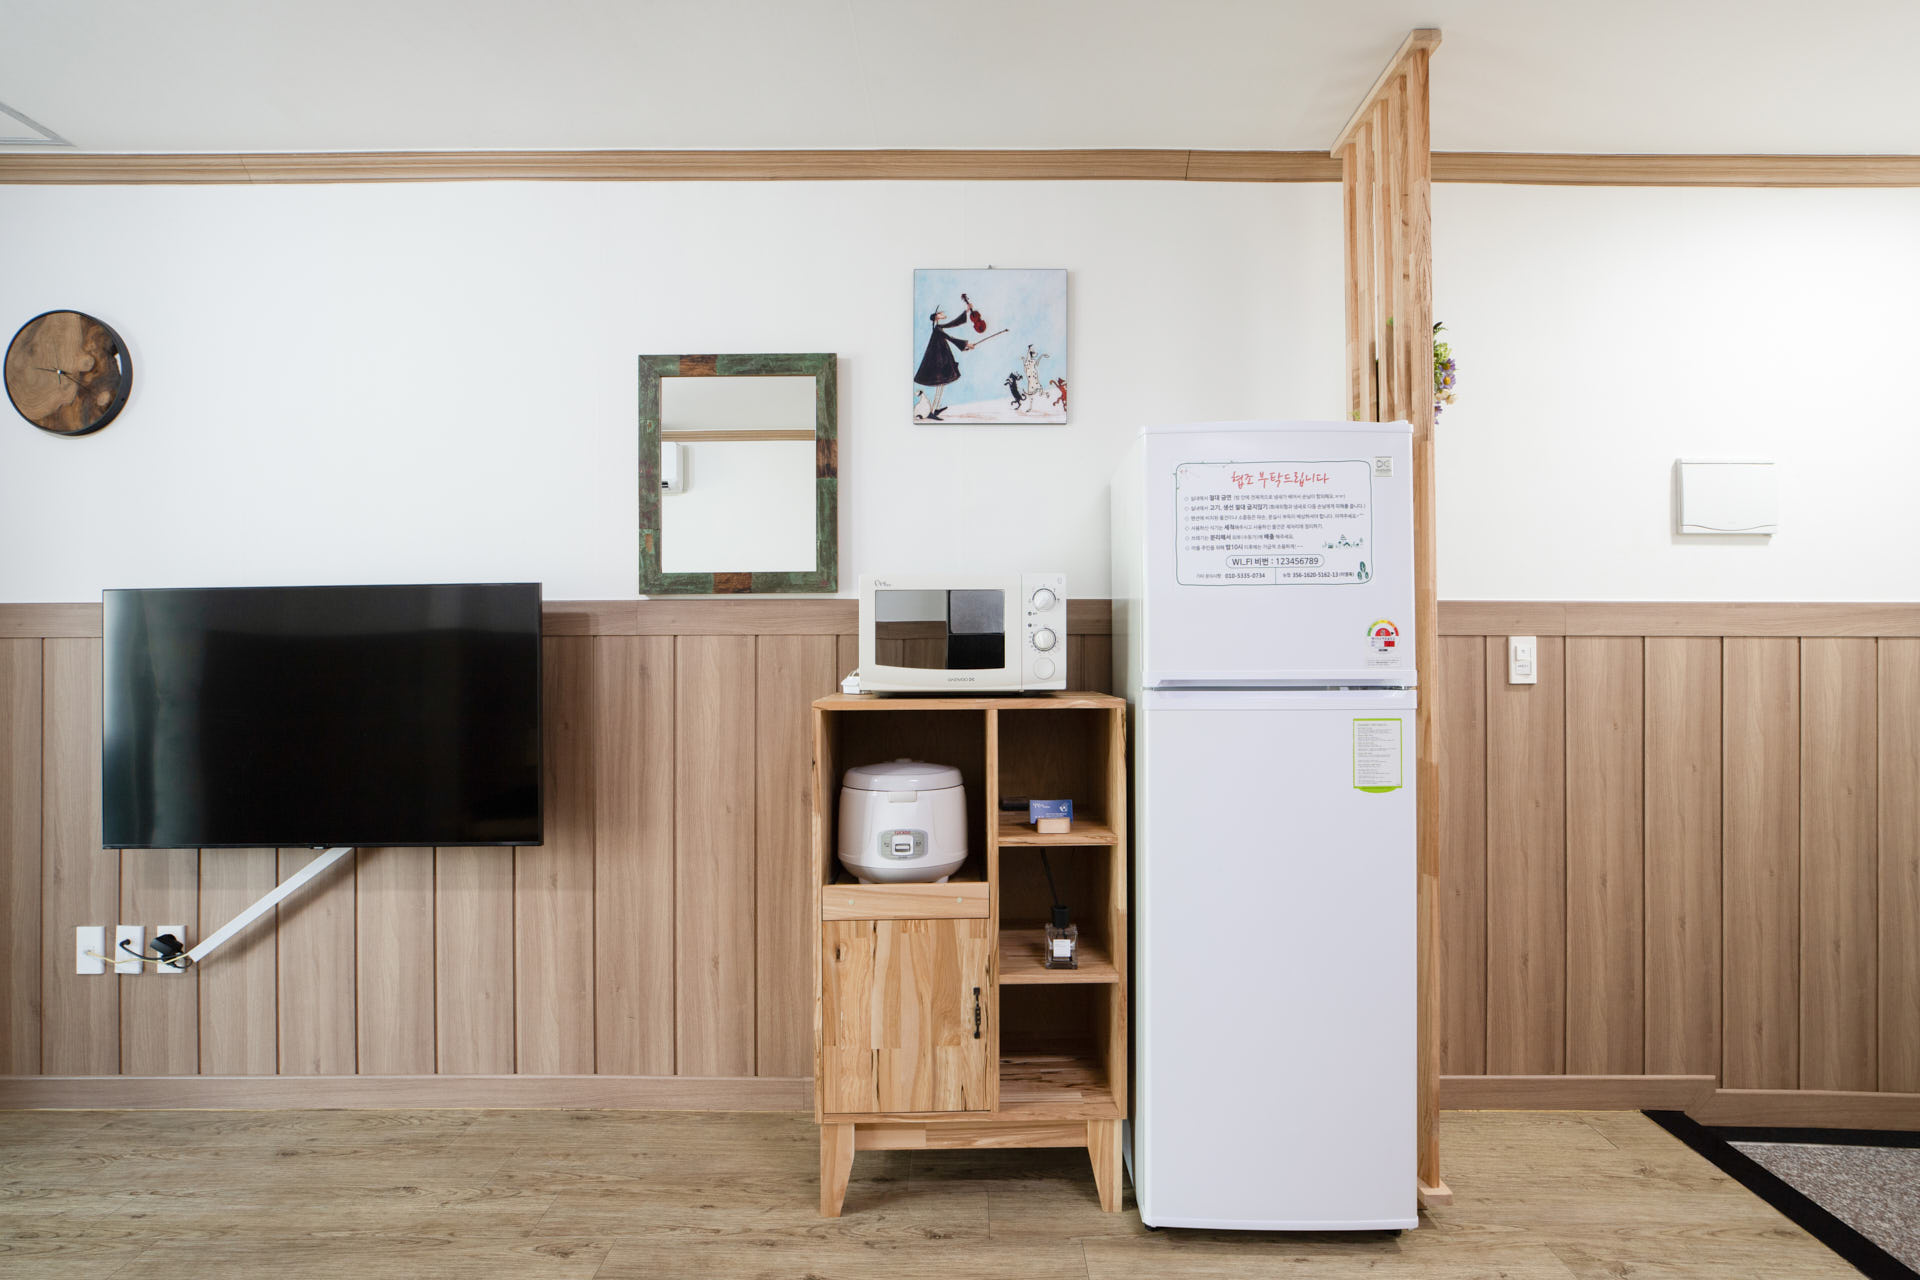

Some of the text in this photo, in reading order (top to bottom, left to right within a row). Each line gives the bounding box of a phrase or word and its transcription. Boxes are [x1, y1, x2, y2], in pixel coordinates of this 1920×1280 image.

[1231, 470, 1330, 489] 협조 부탁드립니다
[1254, 558, 1269, 566] 비번
